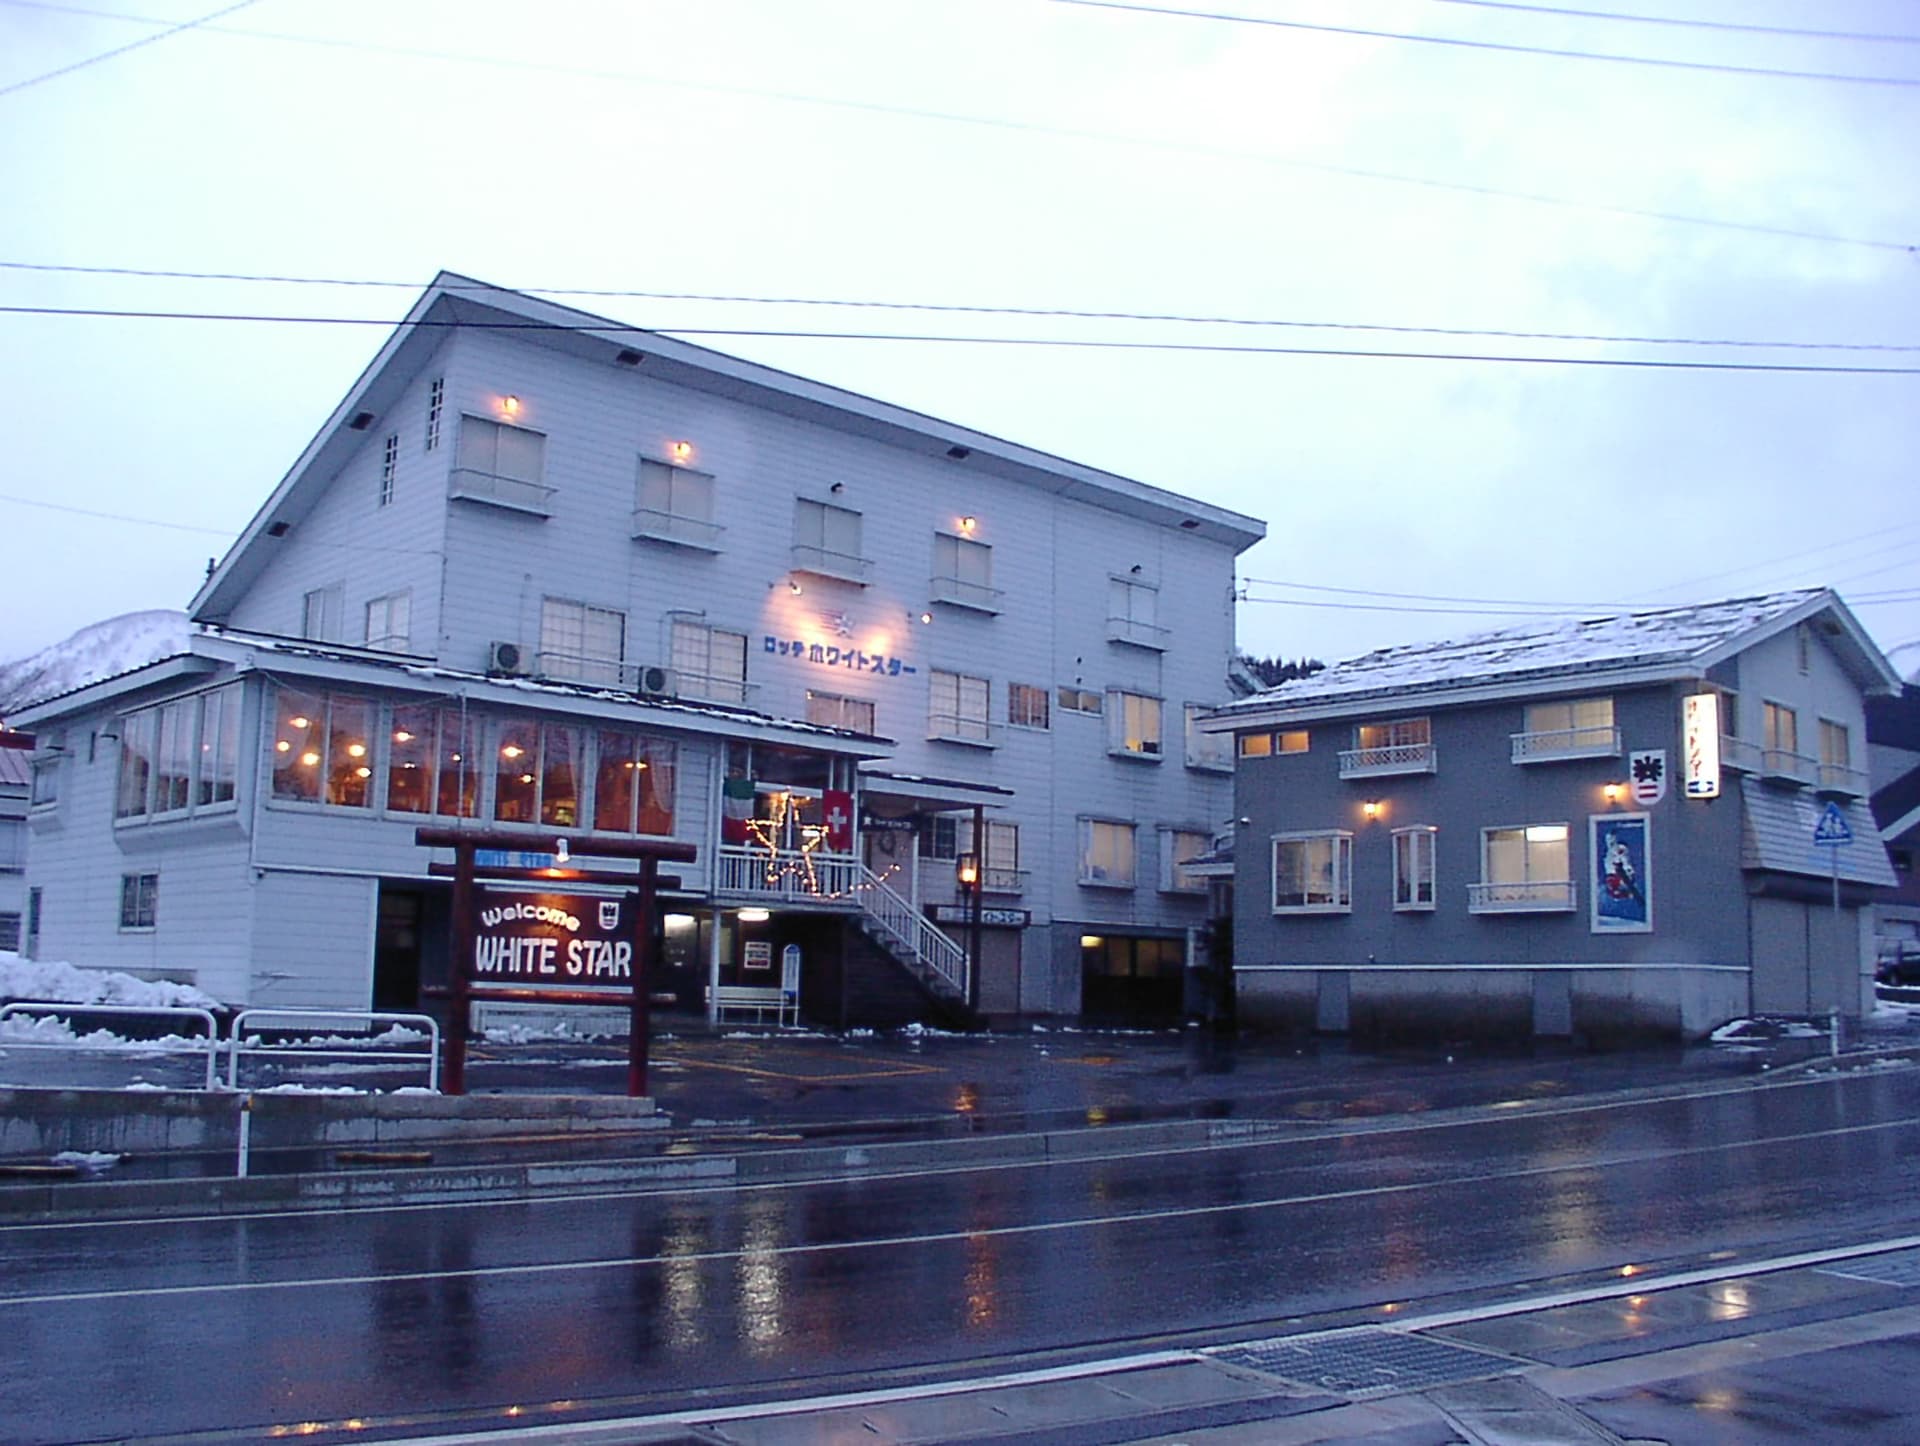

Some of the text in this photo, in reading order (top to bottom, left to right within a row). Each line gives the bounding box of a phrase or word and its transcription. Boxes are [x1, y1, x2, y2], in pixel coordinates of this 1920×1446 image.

[809, 643, 917, 676] ホワイトスター
[475, 934, 632, 977] WHITE STAR
